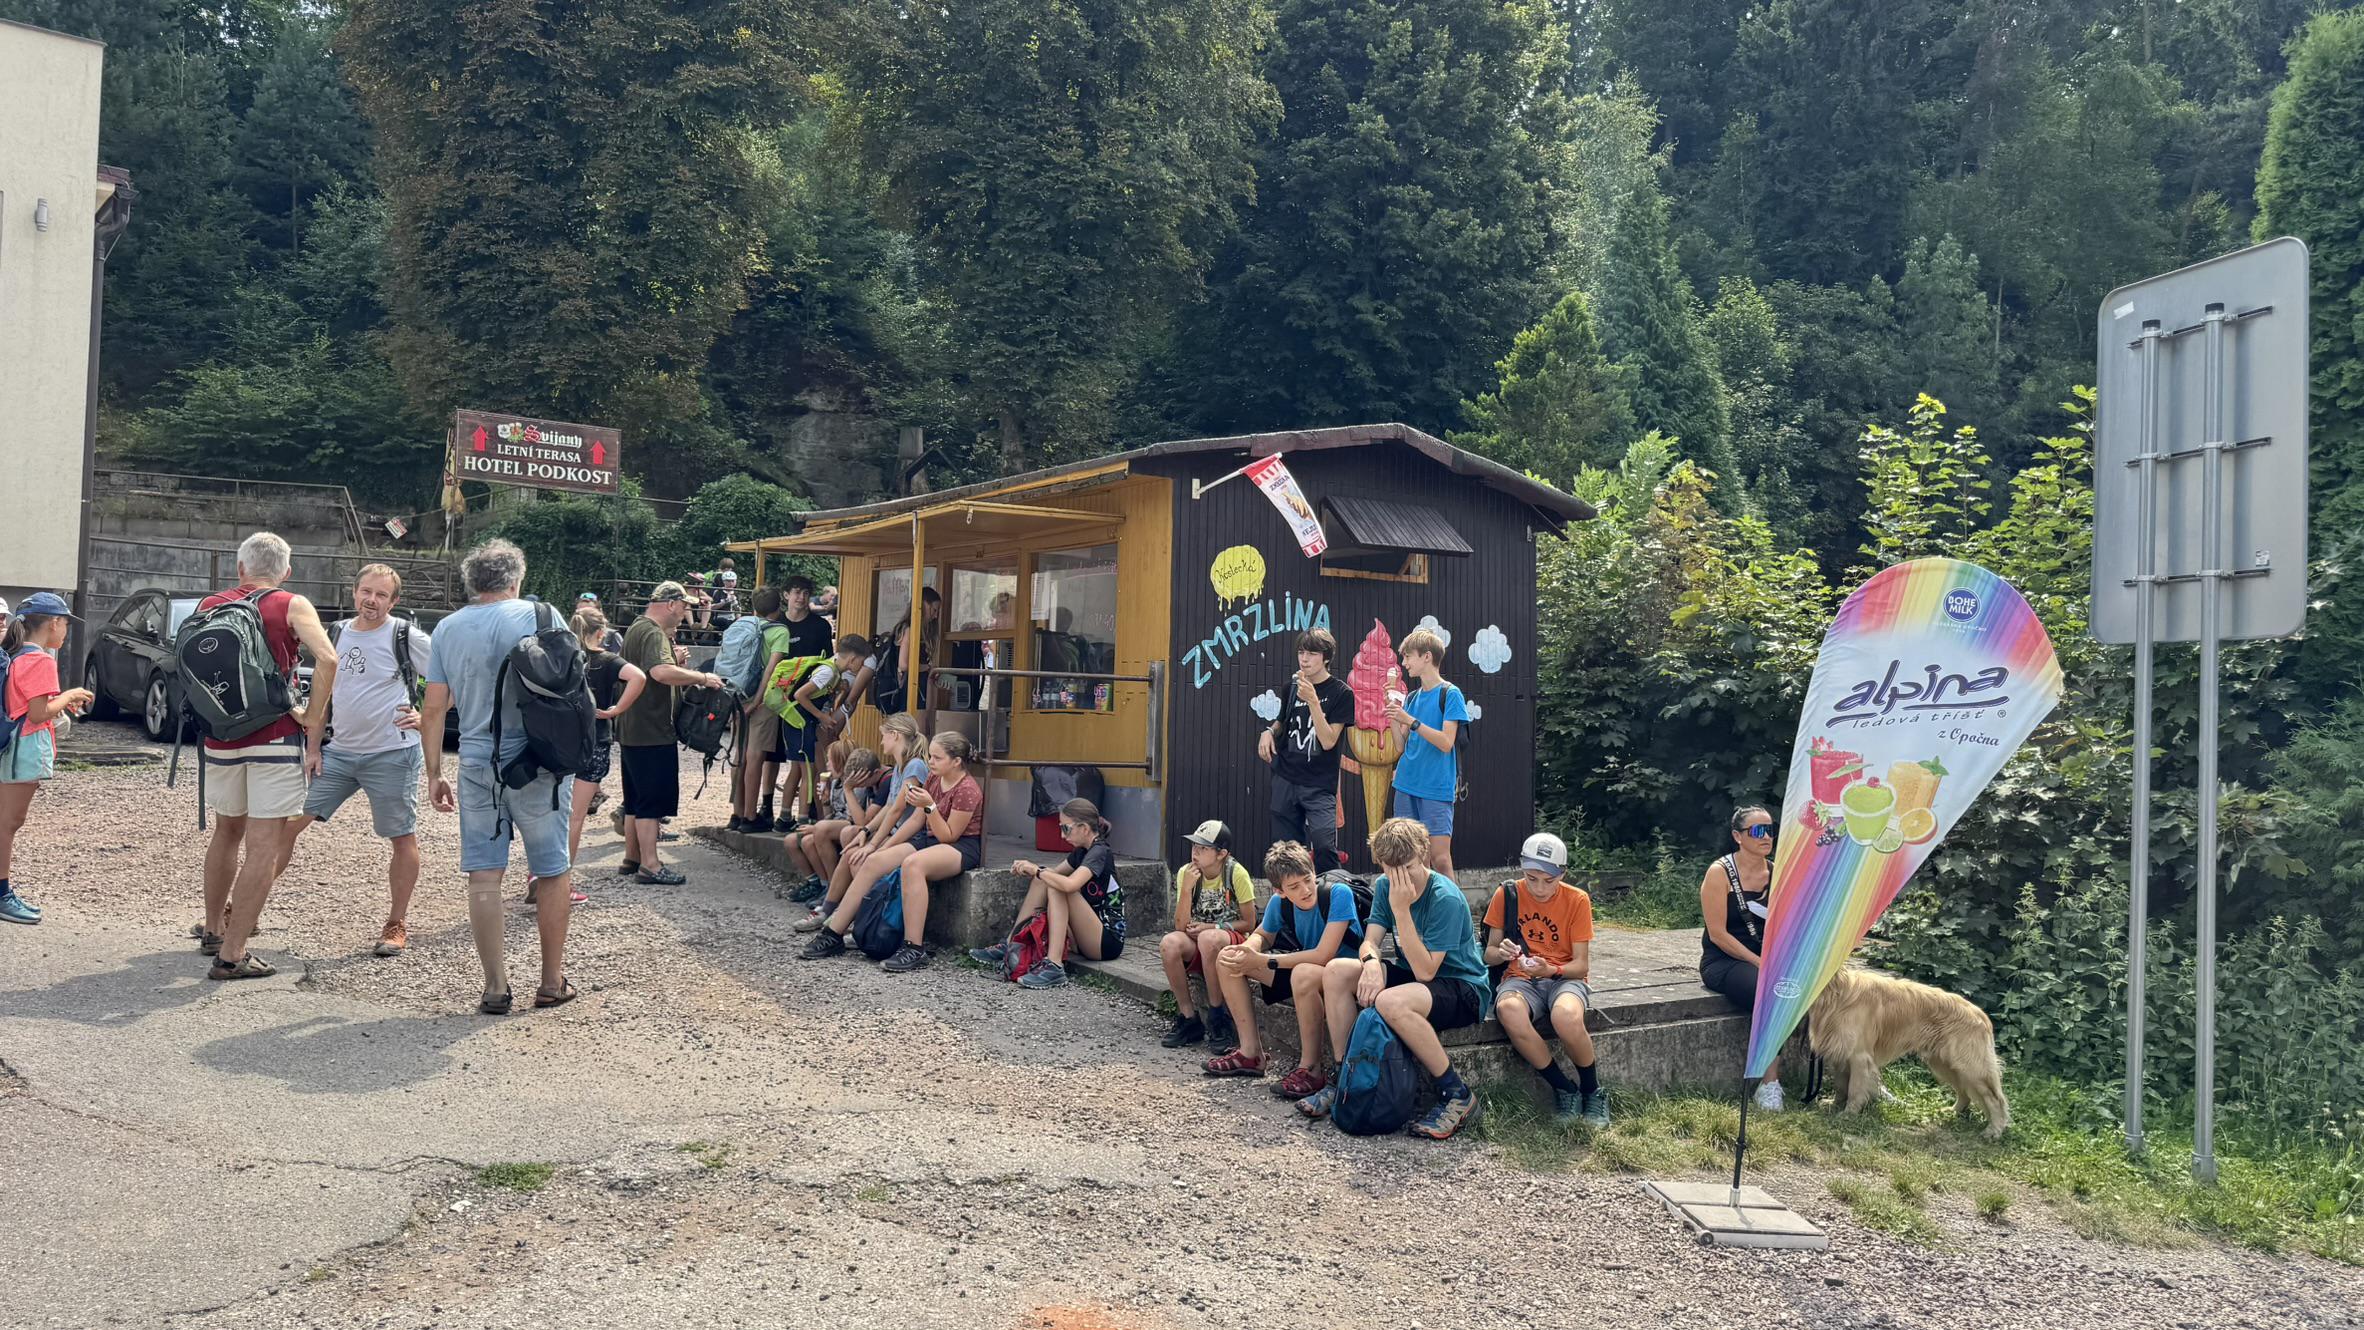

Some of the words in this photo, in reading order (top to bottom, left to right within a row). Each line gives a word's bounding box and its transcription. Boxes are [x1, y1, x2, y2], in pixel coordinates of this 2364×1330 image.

[524, 424, 583, 448] Svijany
[497, 444, 534, 458] LETNÍ
[535, 448, 582, 463] TERASA
[464, 456, 523, 476] HOTEL
[527, 462, 613, 485] PODKOST
[1949, 604, 1973, 615] MILK
[1833, 659, 2010, 715] alpina
[1938, 729, 1946, 739] z
[1950, 727, 2001, 746] Opočna
